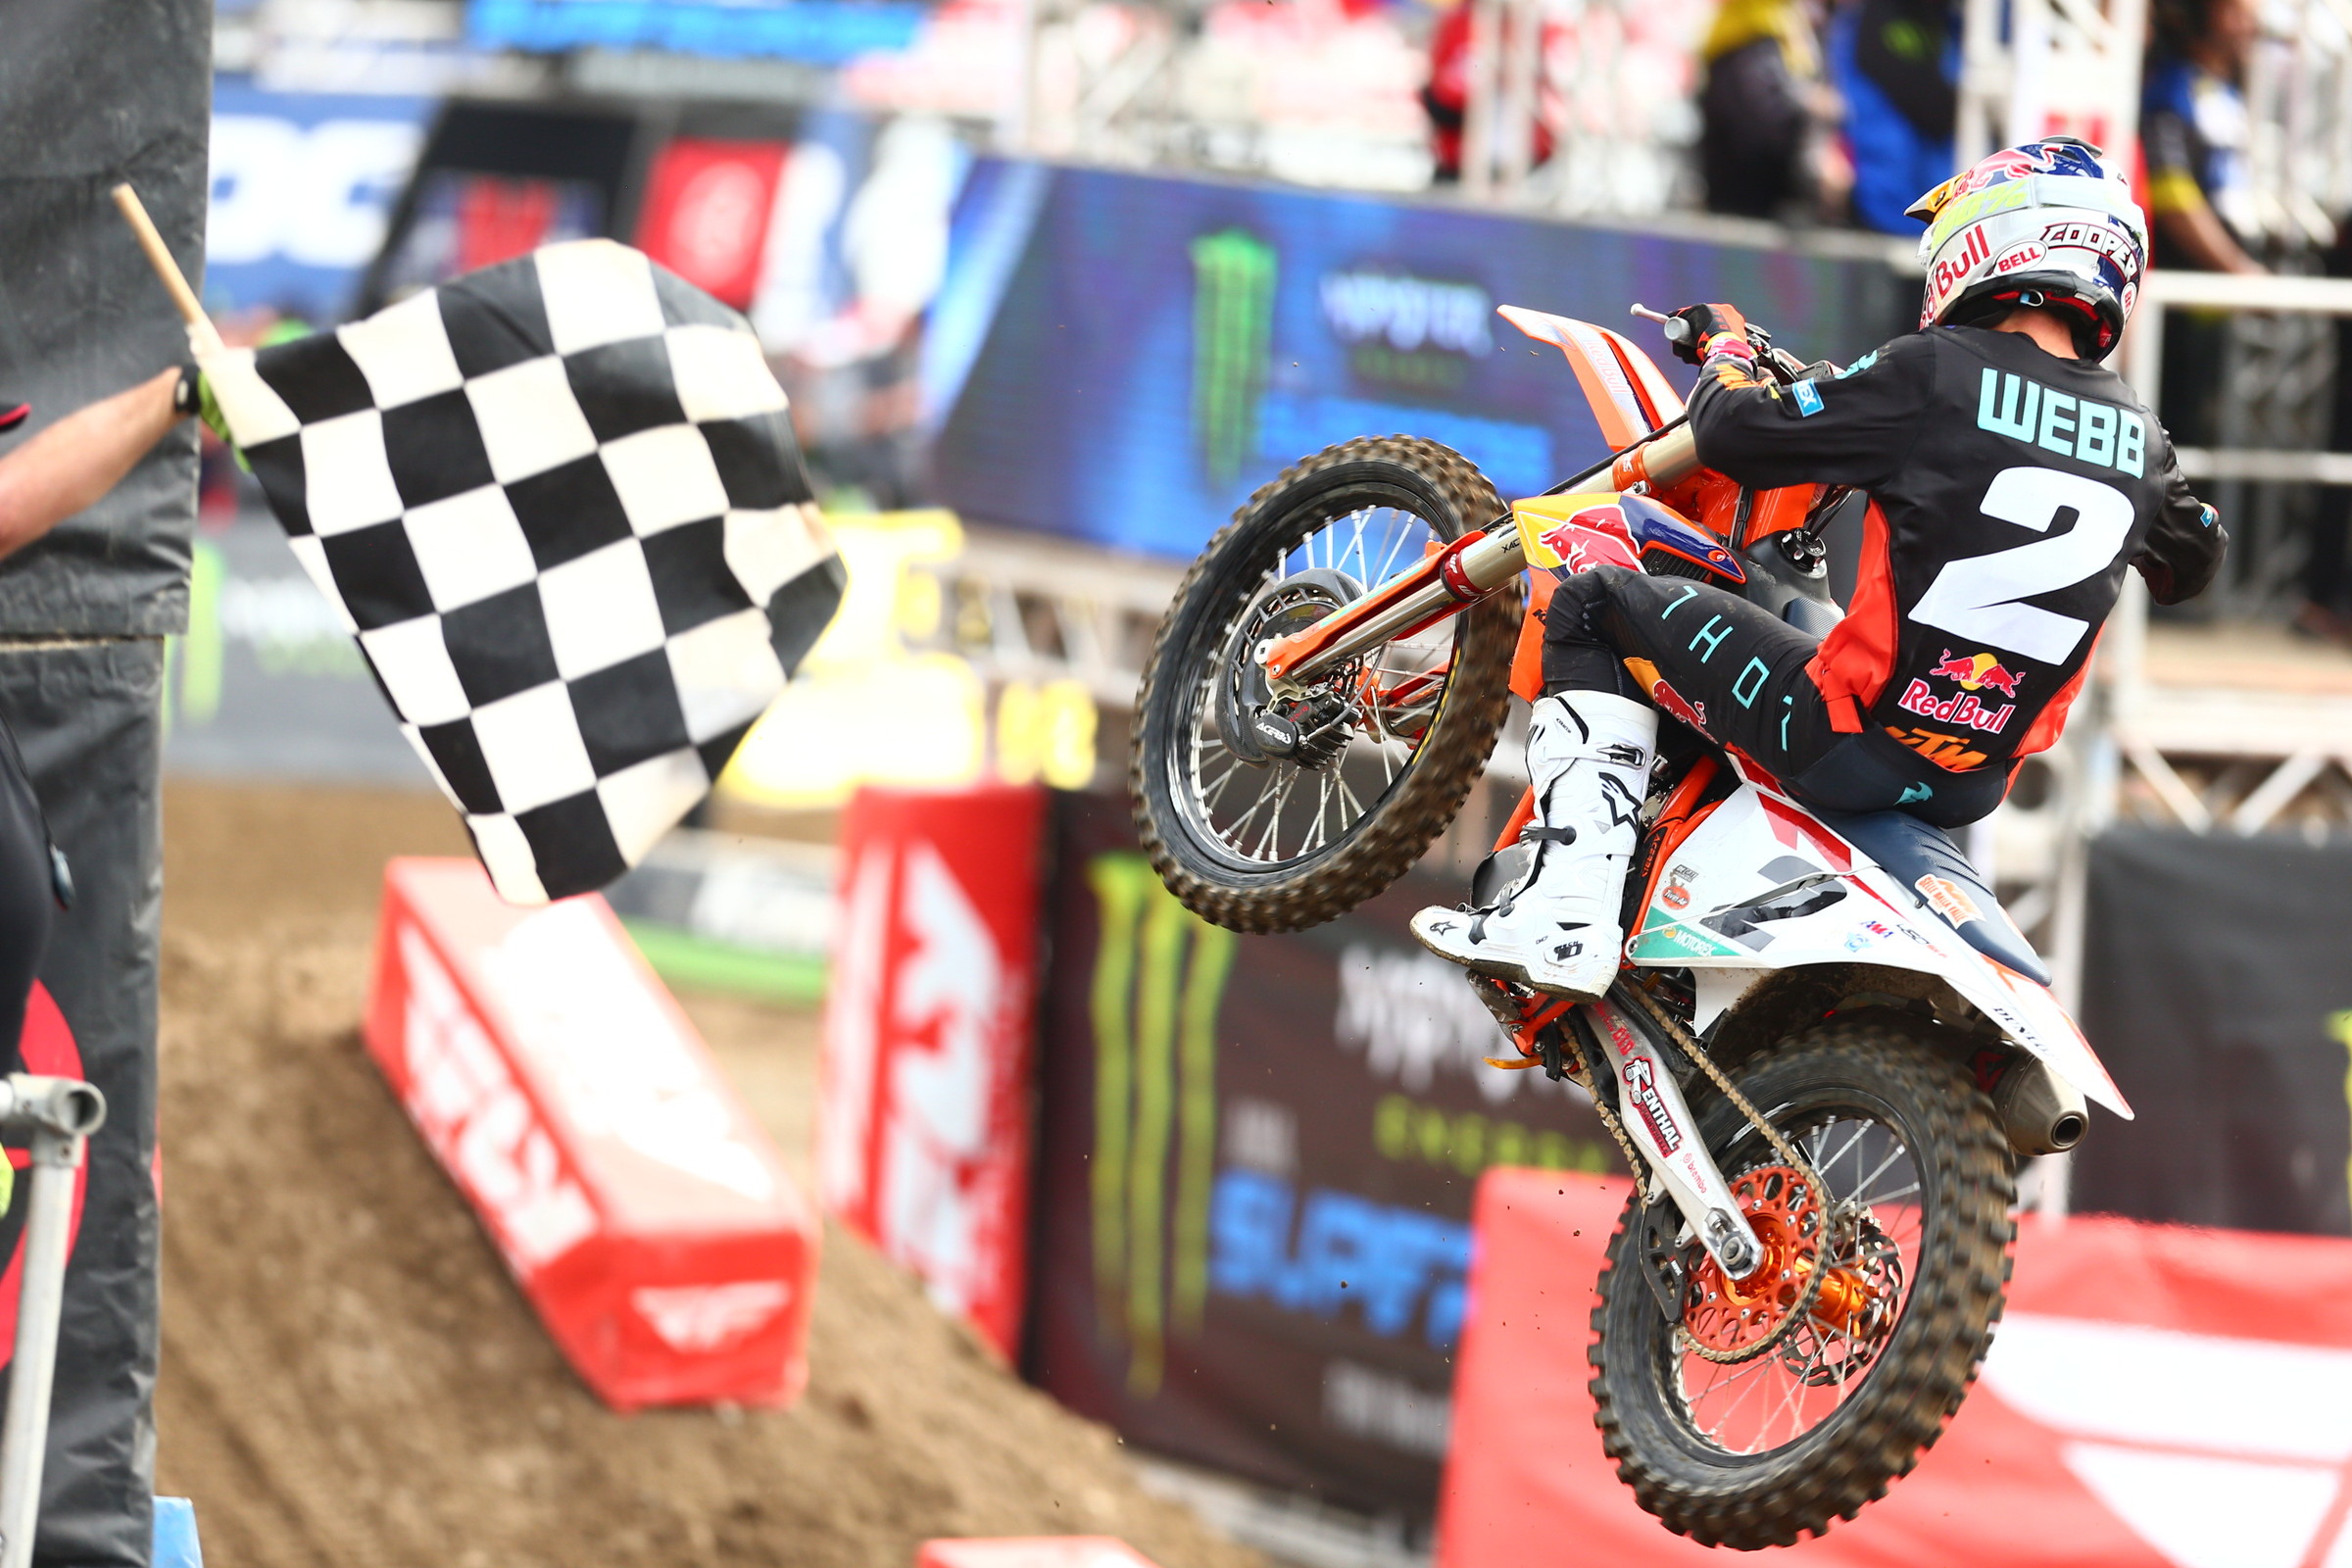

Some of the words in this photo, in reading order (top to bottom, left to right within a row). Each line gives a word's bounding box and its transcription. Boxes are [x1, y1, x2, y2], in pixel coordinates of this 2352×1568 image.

[1936, 224, 1990, 297] Bull
[1998, 247, 2040, 272] BELL
[2044, 223, 2138, 282] COOPER
[1977, 368, 2146, 479] WEBB
[1907, 466, 2136, 666] 2
[1899, 678, 1964, 721] Red
[1960, 694, 2017, 735] Bull
[1886, 726, 1988, 771] KTM
[1673, 930, 1718, 957] MOTOREX
[1860, 920, 1894, 939] AMA
[1687, 1160, 1707, 1195] brembo
